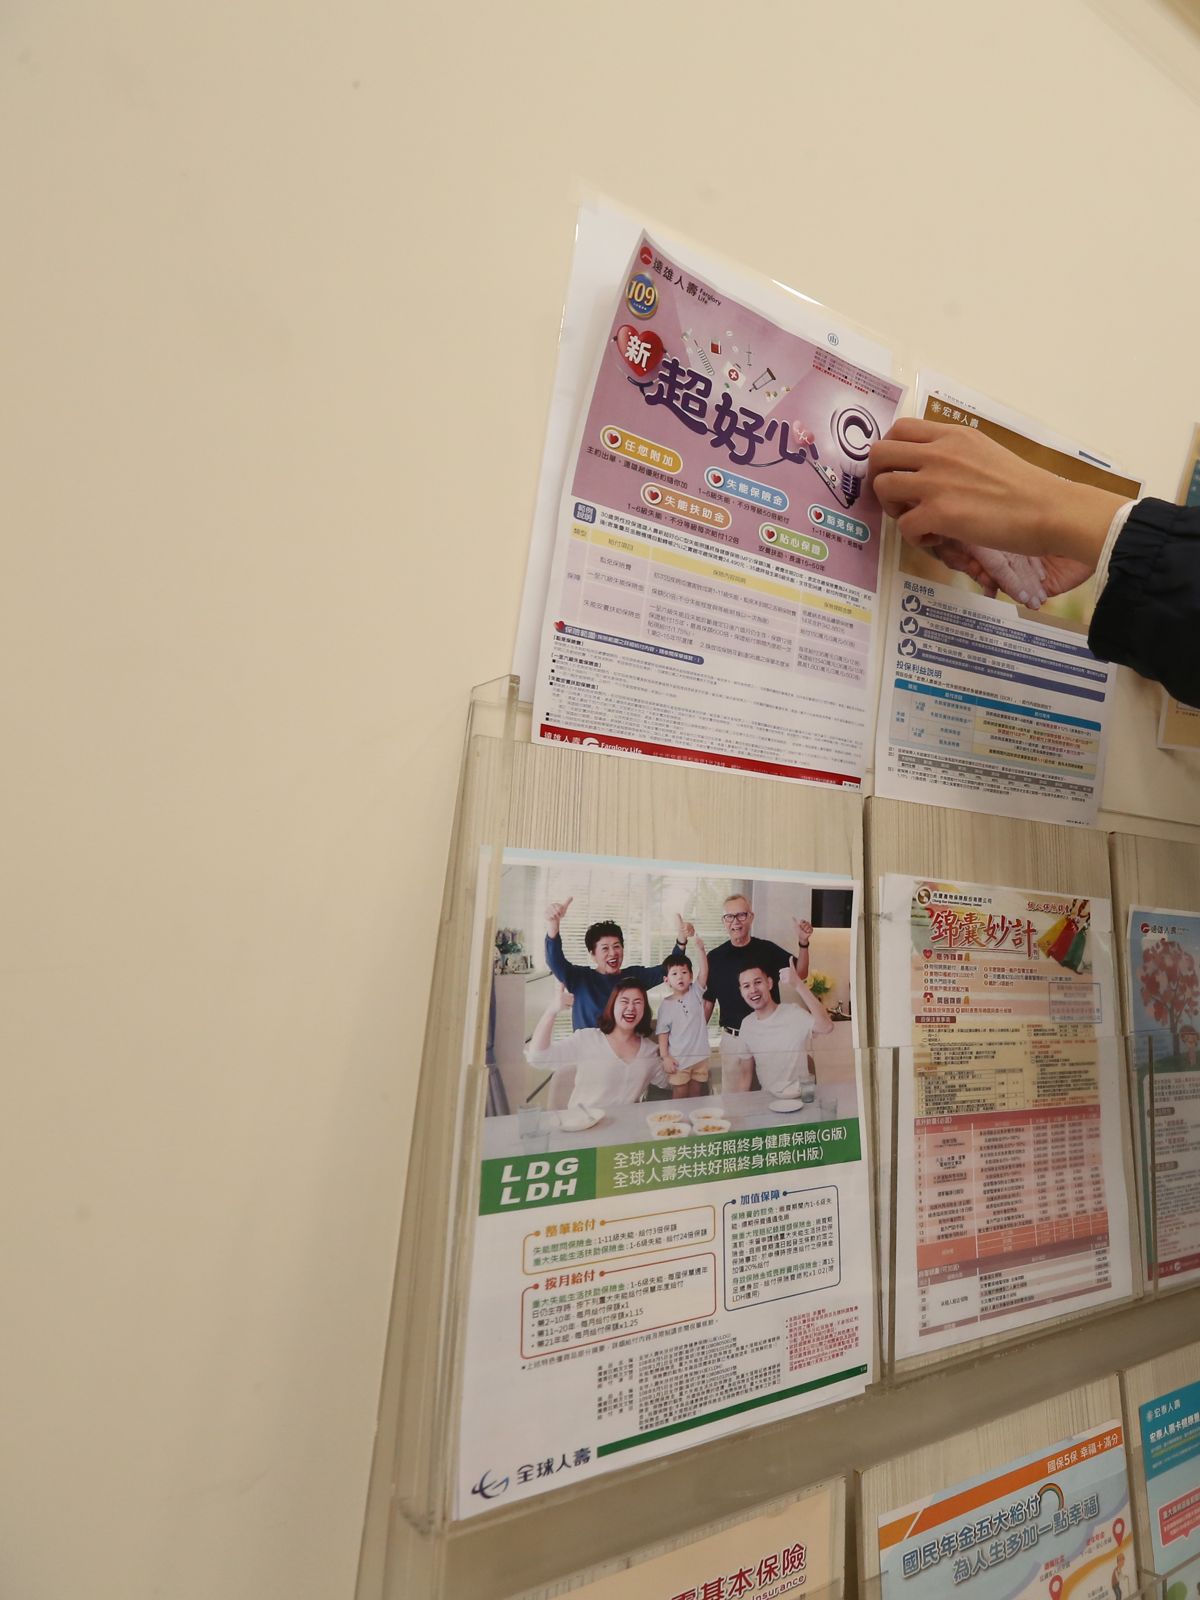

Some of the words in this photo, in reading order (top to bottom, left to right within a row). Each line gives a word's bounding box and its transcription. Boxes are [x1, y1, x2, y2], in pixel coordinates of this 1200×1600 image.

[653, 258, 698, 296] 遠雄人壽
[628, 280, 655, 306] 109
[625, 332, 652, 371] 新
[942, 406, 980, 429] 宏泰人壽
[726, 479, 784, 507] 失能保險金
[903, 581, 935, 598] 商品特色
[930, 910, 1038, 961] 錦囊妙計
[614, 1126, 848, 1170] 全球人壽失扶好照終身健康保險(G版)
[500, 1156, 579, 1184] LDG
[614, 1146, 824, 1190] 全球人壽失扶好照終身保險(H版)
[500, 1179, 578, 1206] LDH
[740, 1189, 781, 1206] 加值保障
[544, 1269, 595, 1291] 按月給付
[517, 1447, 592, 1485] 全球人壽
[1047, 1451, 1078, 1474] 國保5保
[902, 1494, 1042, 1578] 國民年金五大給付
[953, 1493, 1100, 1585] 為人生多加一點幸福
